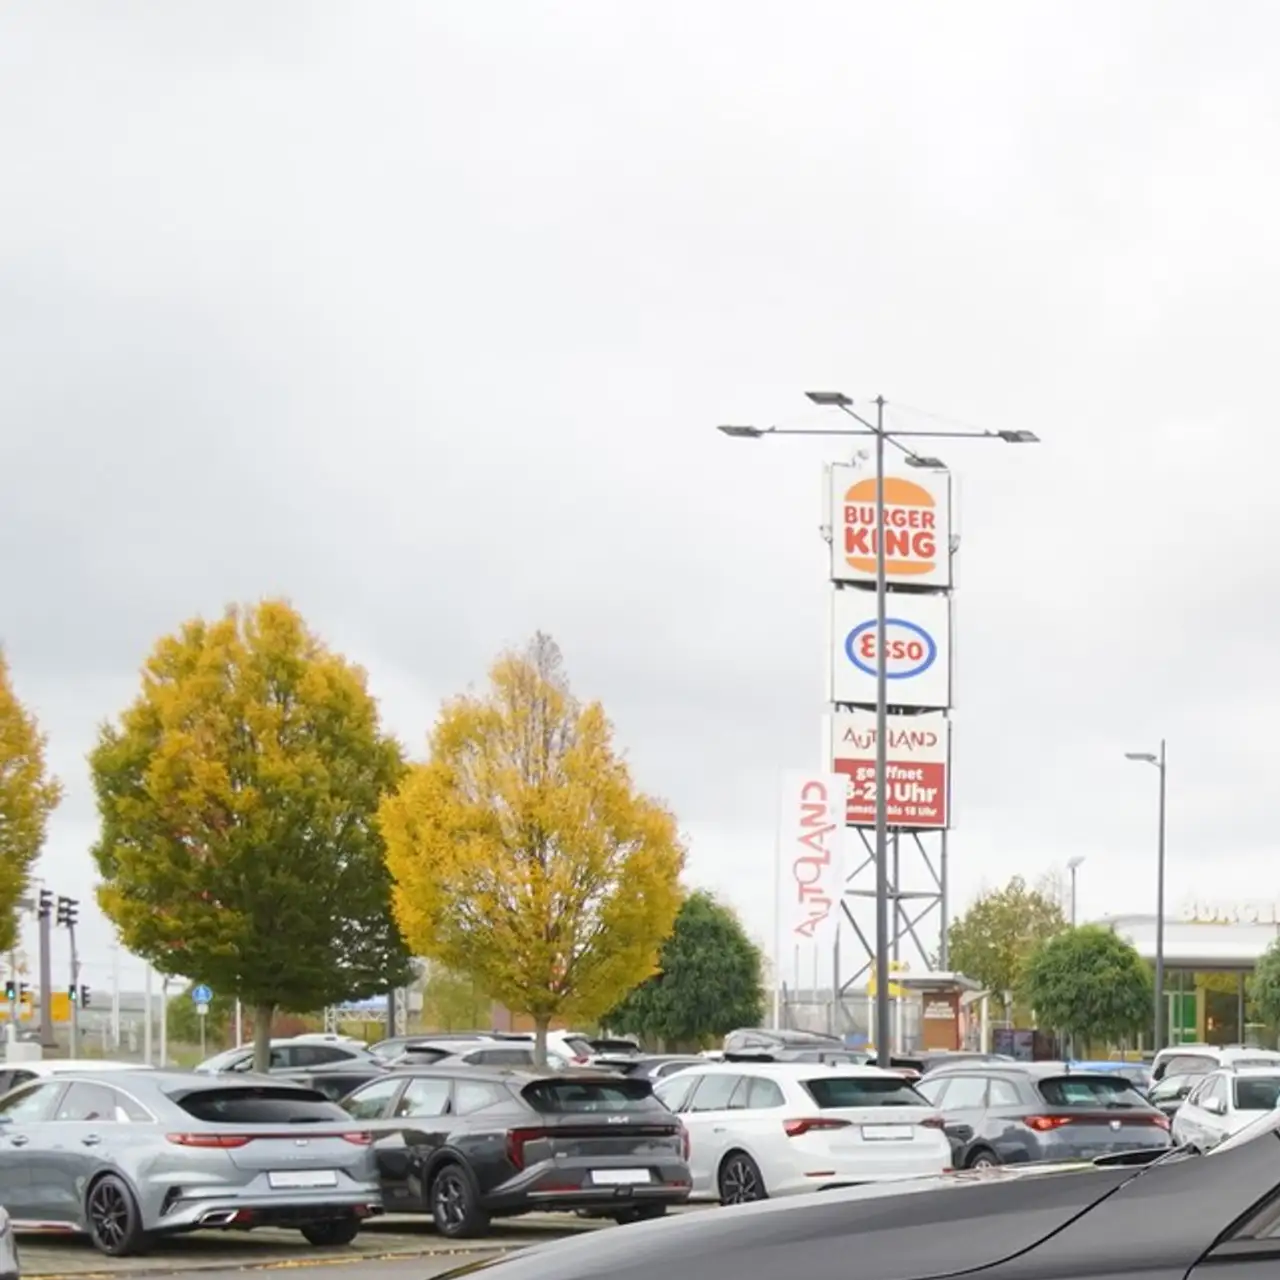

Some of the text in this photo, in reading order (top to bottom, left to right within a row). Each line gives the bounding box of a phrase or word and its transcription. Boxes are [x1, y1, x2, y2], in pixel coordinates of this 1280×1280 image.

[845, 526, 936, 559] KING
[842, 727, 938, 752] AUTLAND
[856, 765, 923, 781] geffnet
[894, 782, 938, 803] Uhr
[793, 781, 837, 937] AUTOLAND
